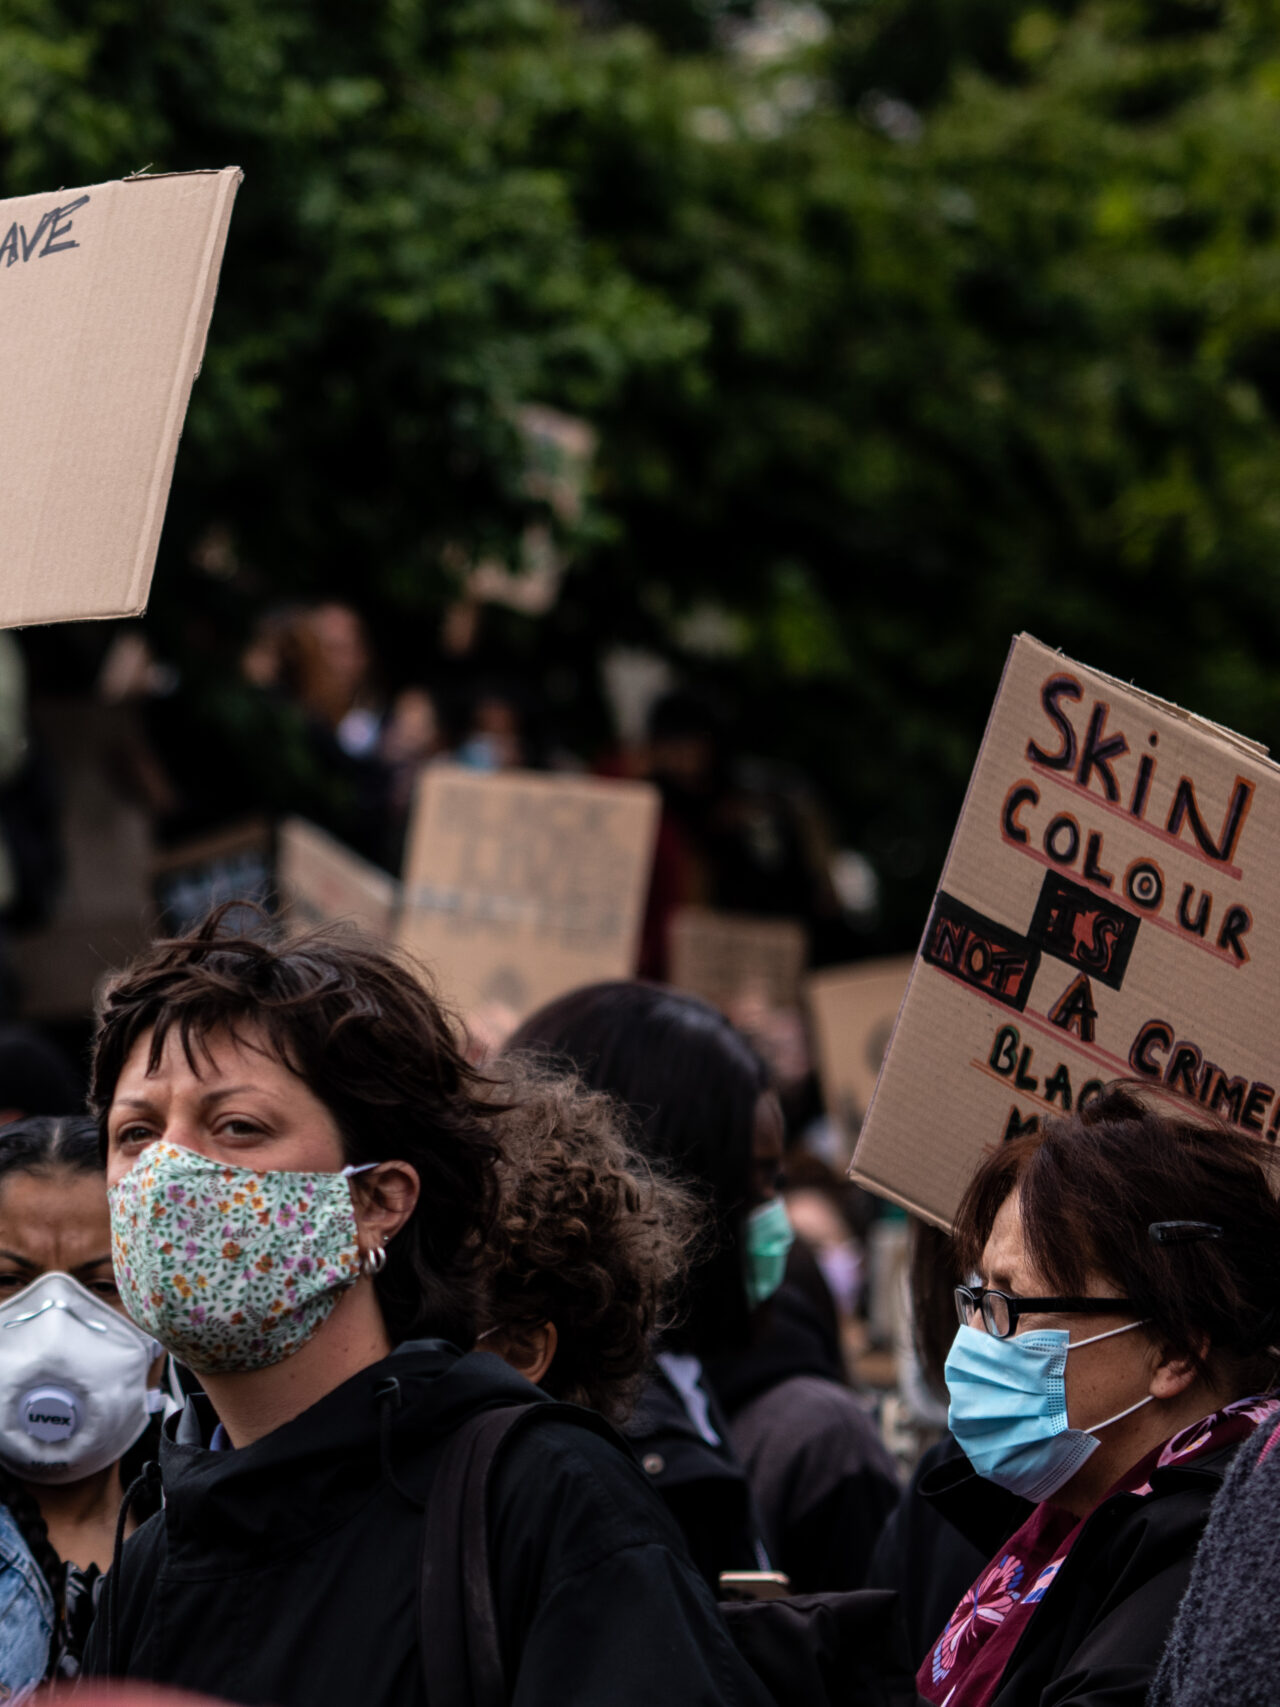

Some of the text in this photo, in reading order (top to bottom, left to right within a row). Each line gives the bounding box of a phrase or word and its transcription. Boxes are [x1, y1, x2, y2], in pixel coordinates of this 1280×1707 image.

[1001, 779, 1252, 962] COLOUR
[930, 916, 1026, 998] NOT
[1047, 972, 1097, 1042] A
[1129, 1018, 1280, 1143] CRIME!
[989, 1023, 1105, 1112] BLAC
[28, 1413, 71, 1426] uvex
